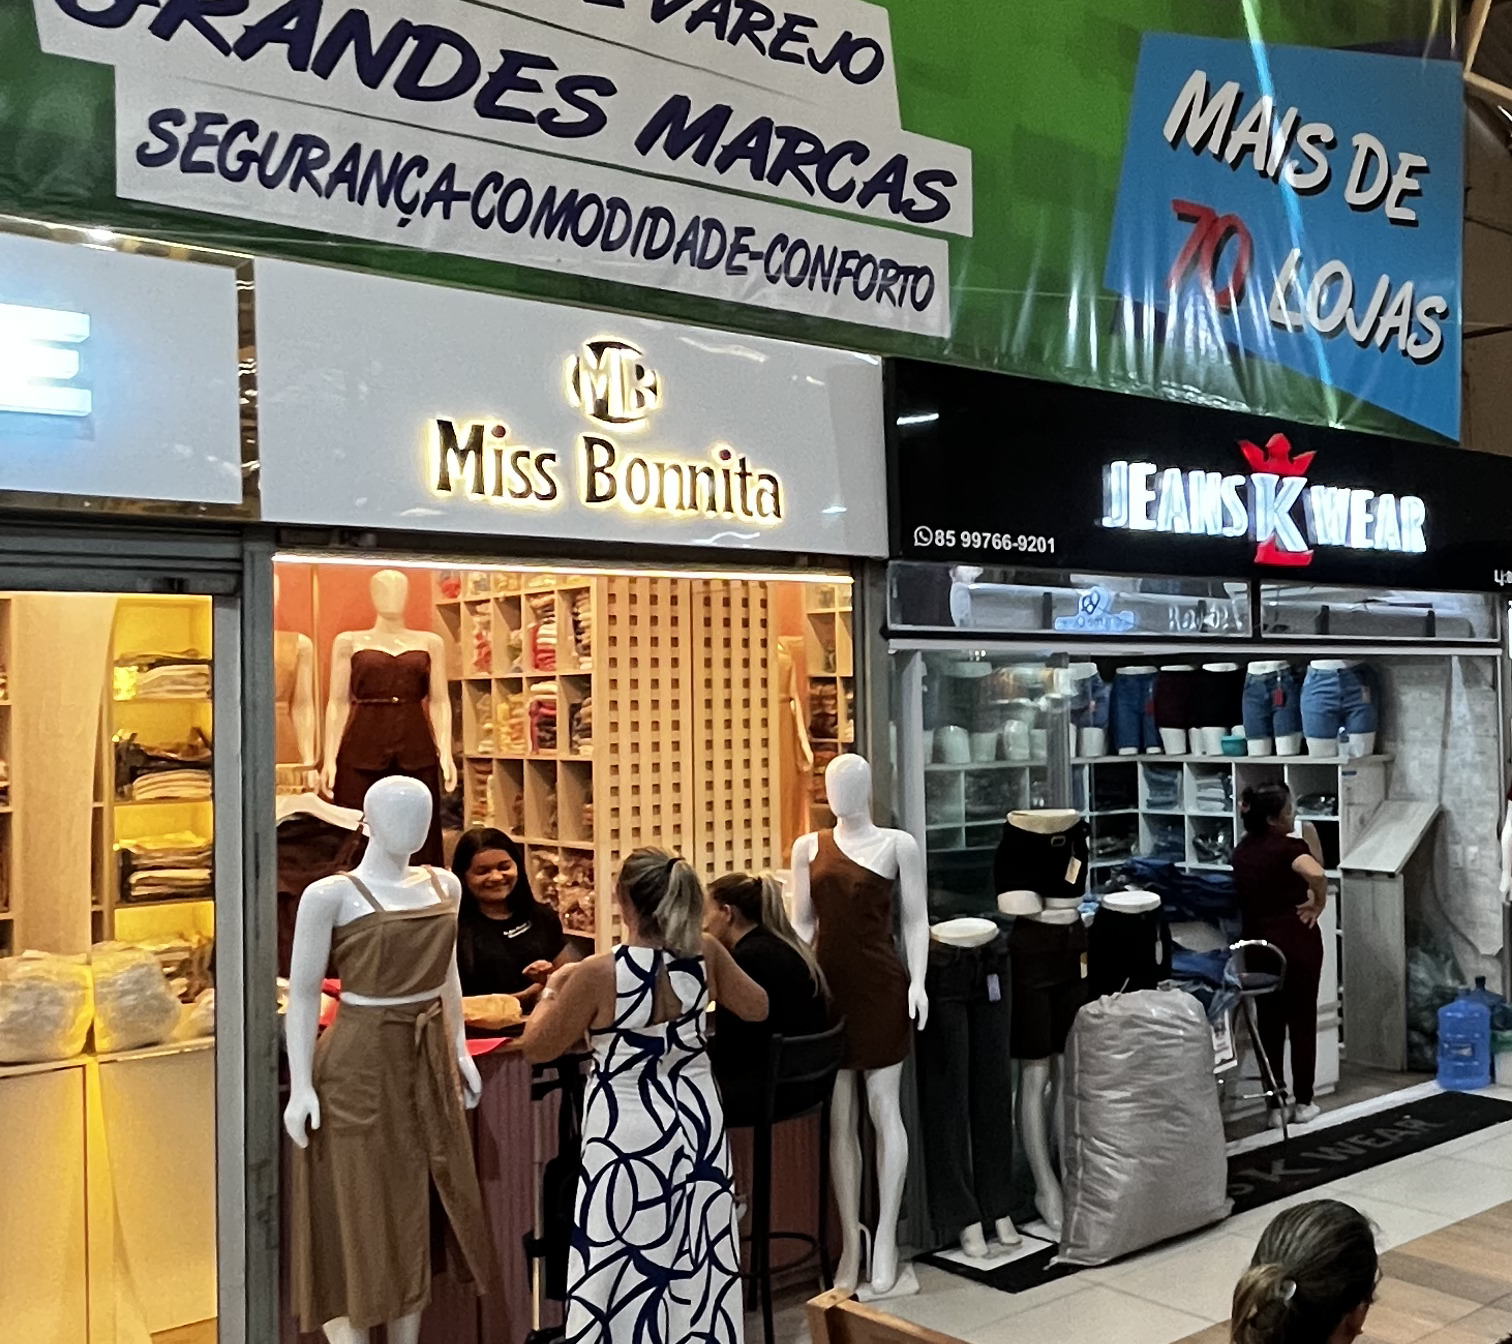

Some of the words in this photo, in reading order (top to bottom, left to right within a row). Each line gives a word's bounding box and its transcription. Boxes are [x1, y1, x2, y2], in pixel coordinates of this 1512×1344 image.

[635, 94, 957, 223] MARCAS
[1163, 69, 1333, 191] MAIS
[1343, 131, 1429, 225] DE
[1165, 199, 1252, 312] 70
[1267, 248, 1448, 362] LOJAS
[436, 419, 558, 502] Miss
[582, 435, 783, 521] Bonnita
[1102, 461, 1248, 537] JEANS
[1250, 473, 1309, 553] K
[1309, 485, 1427, 553] WEAR
[934, 529, 956, 547] 85
[961, 530, 1055, 553] 99766-9201
[1299, 1119, 1446, 1162] WEAR
